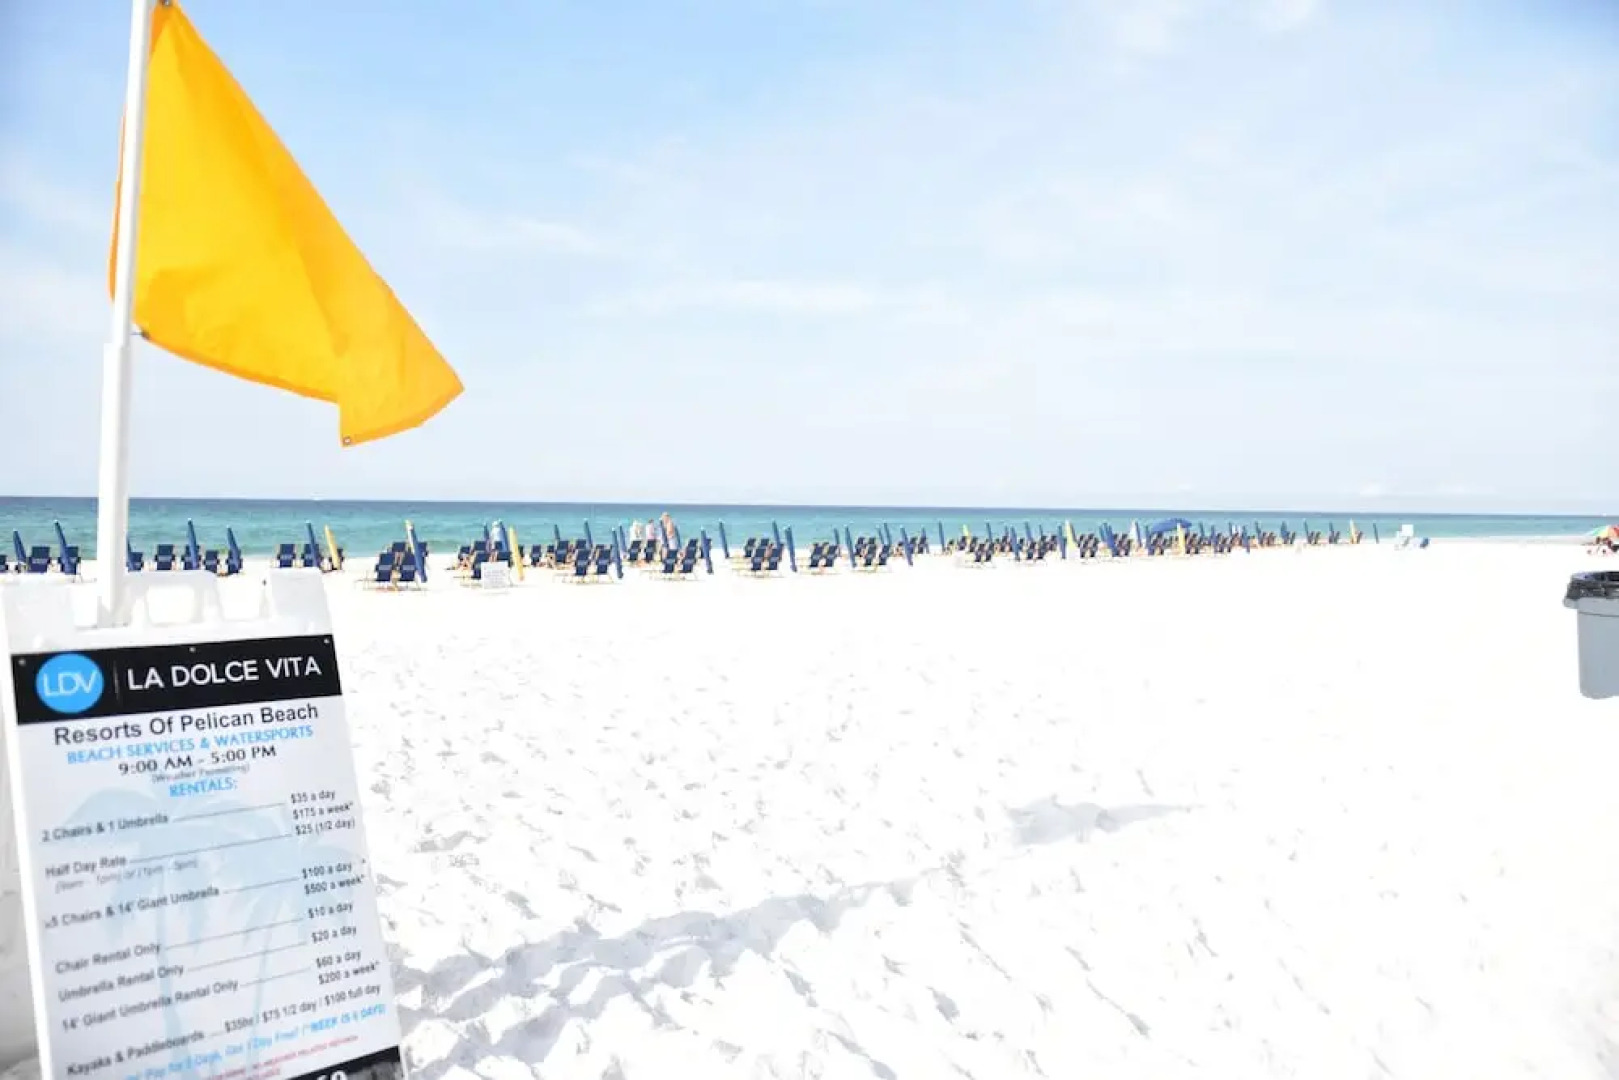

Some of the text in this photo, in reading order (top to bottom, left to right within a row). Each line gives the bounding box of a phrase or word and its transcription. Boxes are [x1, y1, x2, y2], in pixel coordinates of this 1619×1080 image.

[43, 670, 98, 697] LDV
[127, 655, 322, 691] LA DOLCE VITA
[54, 703, 319, 745] Resorts Of Pelican Beach
[67, 725, 313, 764] BEACH SERVICES & WATERSPORTS
[118, 759, 158, 775] 9:00
[165, 754, 193, 770] AM
[211, 748, 246, 765] 5:00
[251, 744, 278, 760] PM
[169, 776, 238, 798] RENTALS:
[290, 789, 336, 804] $35 a day
[52, 822, 92, 840] Chairs
[117, 811, 169, 830] Umbrella
[293, 807, 316, 820] $175
[295, 823, 313, 836] $25
[334, 817, 356, 830] day)
[45, 856, 126, 878] Half Day Rate
[302, 865, 325, 879] $100
[335, 862, 353, 873] day
[304, 881, 327, 895] $500
[62, 910, 102, 926] Chairs
[137, 895, 168, 909] Giant
[170, 884, 219, 905] Umbrella
[308, 906, 326, 919] $10
[336, 902, 353, 913] day
[311, 930, 329, 944] $20
[340, 926, 357, 937] day
[55, 943, 161, 974] Chair Rental Only
[315, 956, 333, 969] $60
[344, 950, 361, 961] day
[58, 965, 184, 1003] Umbrella Rental Only
[318, 971, 341, 985] $200
[83, 1010, 117, 1026] Giant
[119, 995, 172, 1018] Umbrella
[175, 984, 210, 1001] Rental
[212, 980, 239, 993] Only
[67, 1056, 111, 1076] Kayaks
[127, 1030, 204, 1058] Paddleboards
[299, 1000, 317, 1013] day
[324, 990, 346, 1006] $100
[365, 984, 381, 996] day
